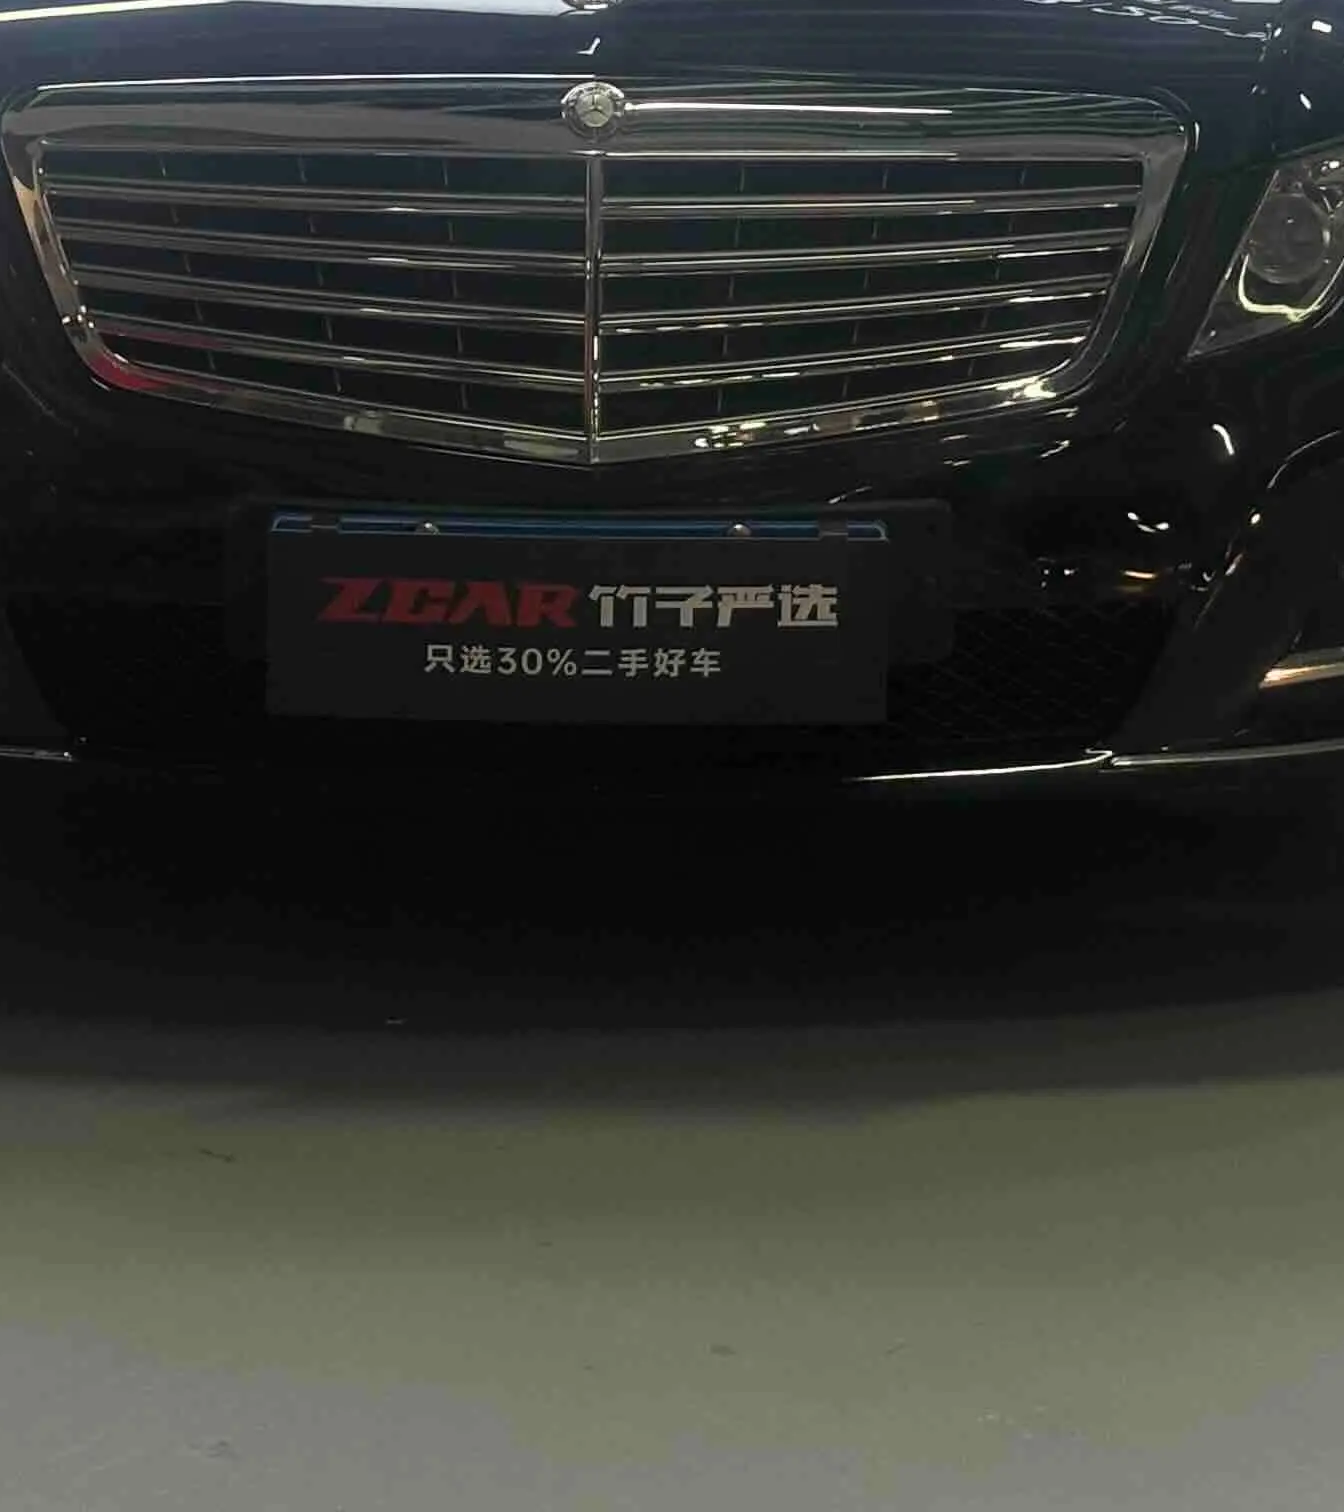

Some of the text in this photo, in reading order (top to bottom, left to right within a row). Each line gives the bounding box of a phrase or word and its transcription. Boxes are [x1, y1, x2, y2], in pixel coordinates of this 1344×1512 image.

[316, 577, 840, 628] ZCAR 竹子严选
[423, 643, 722, 678] 只选30%二手好车
